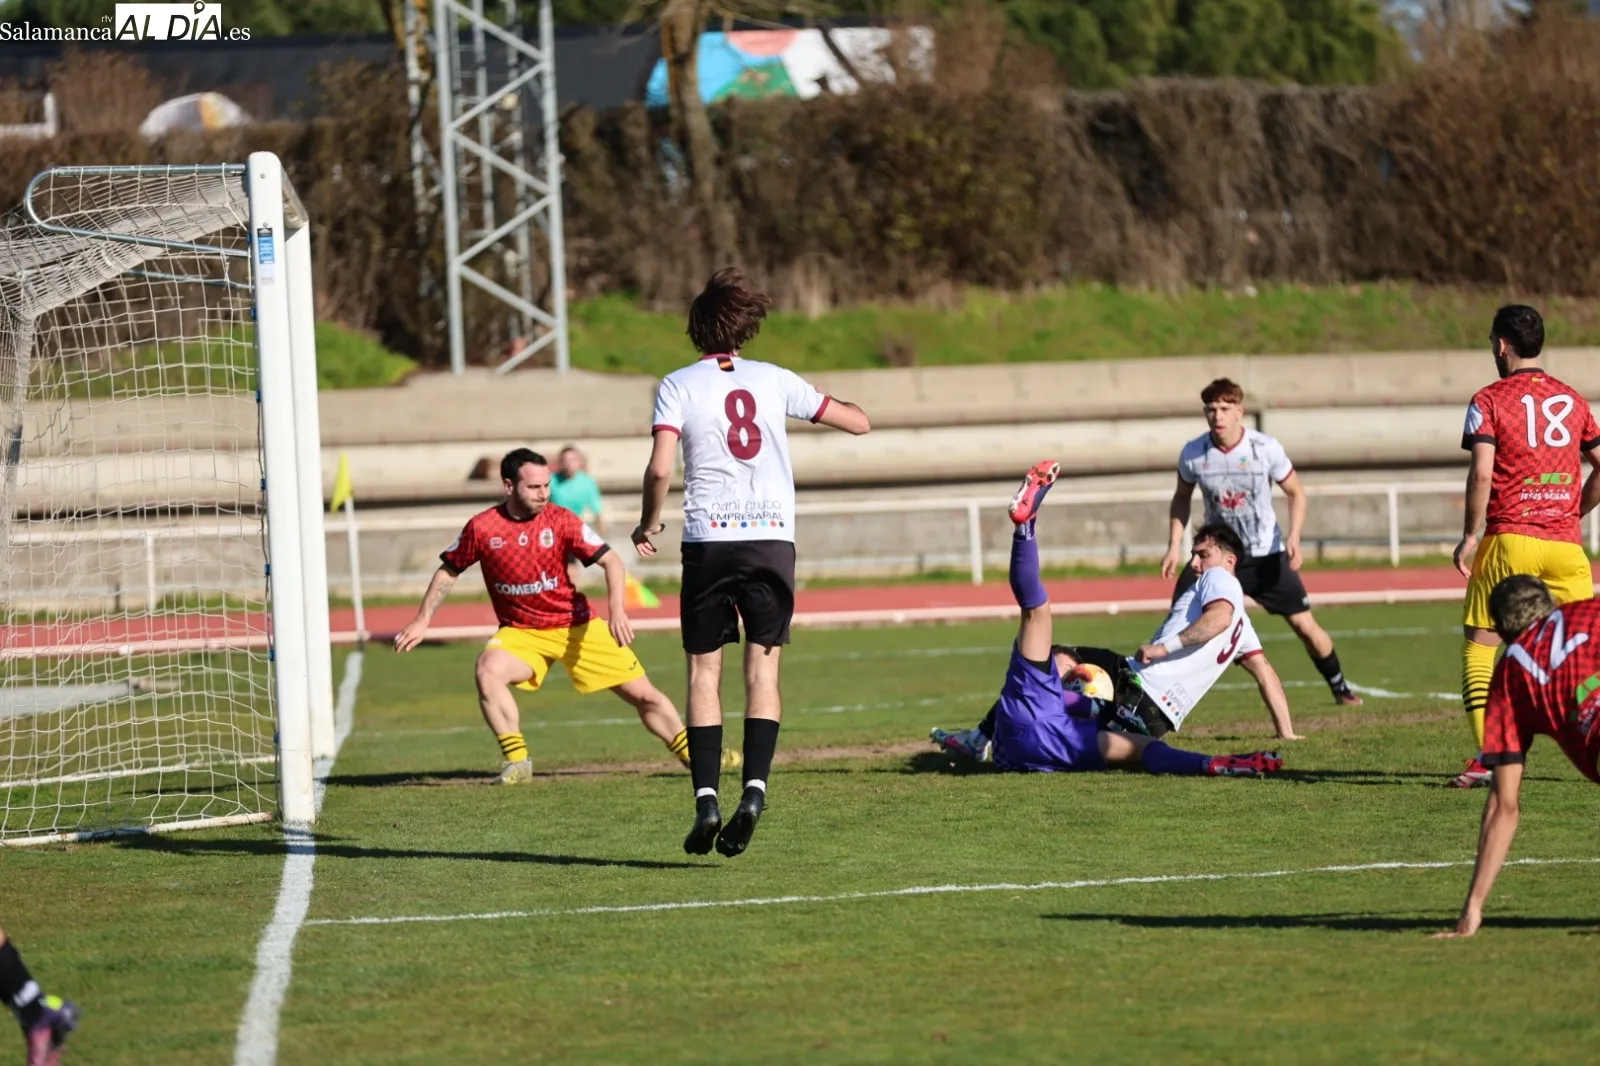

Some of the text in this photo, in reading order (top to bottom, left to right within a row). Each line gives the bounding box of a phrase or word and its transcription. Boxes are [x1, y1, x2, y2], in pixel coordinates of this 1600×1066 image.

[724, 389, 762, 461] 8
[1520, 393, 1575, 449] 18
[518, 531, 529, 547] 6
[710, 511, 784, 521] EMPRESARIAL
[1216, 616, 1244, 665] 9
[1506, 609, 1589, 686] 12
